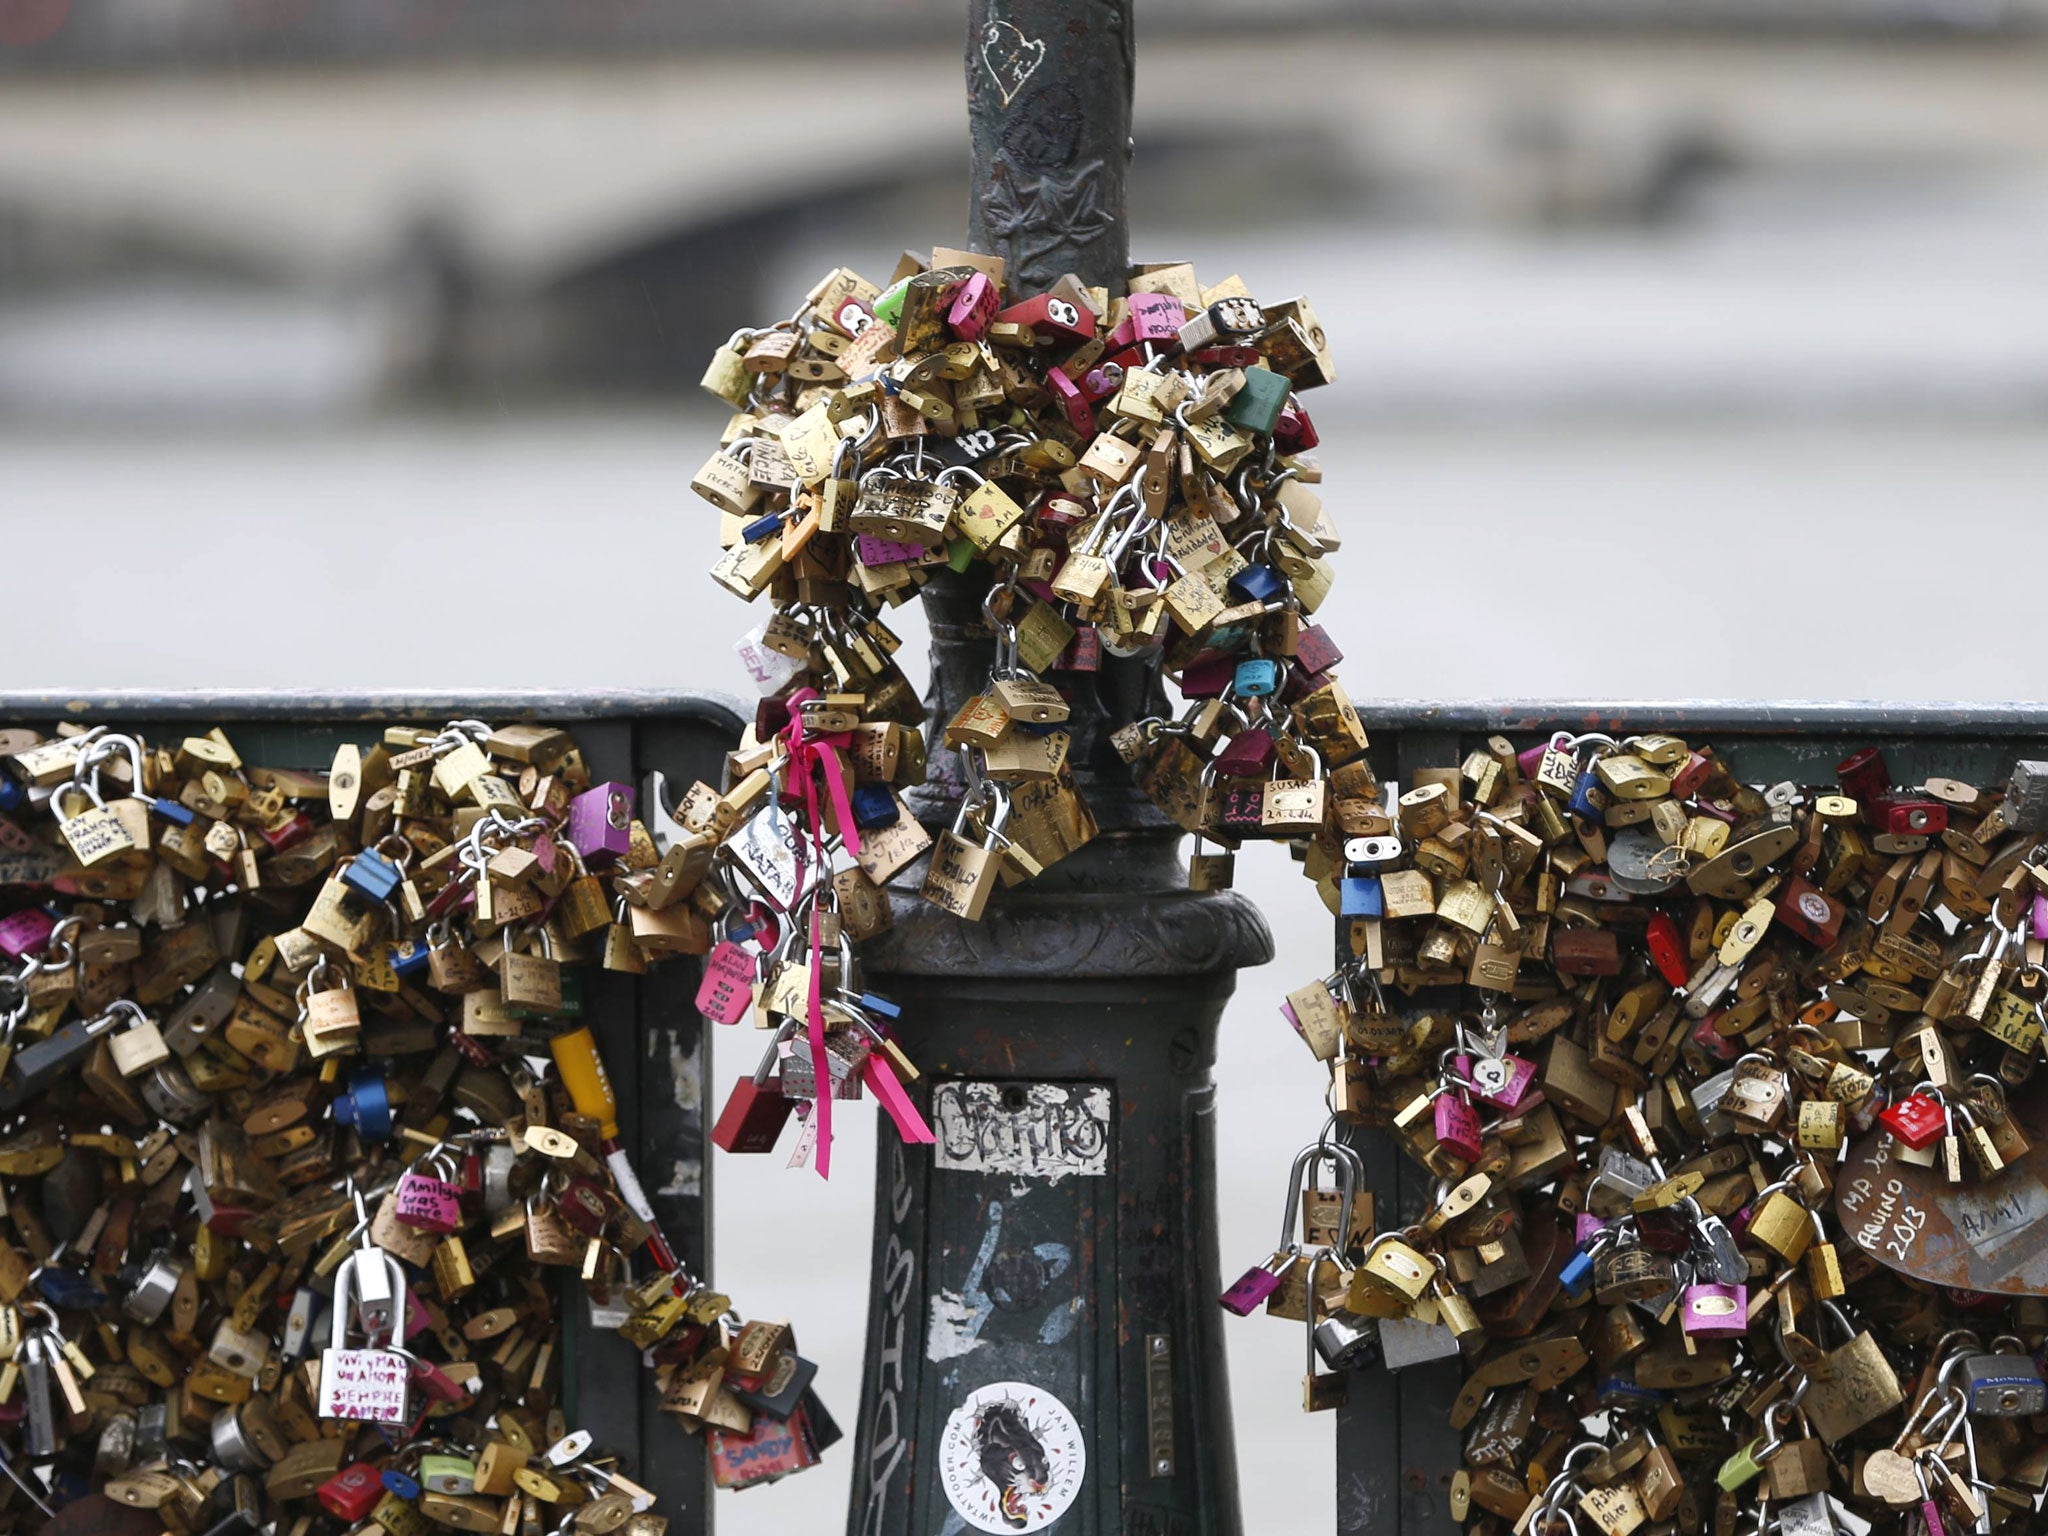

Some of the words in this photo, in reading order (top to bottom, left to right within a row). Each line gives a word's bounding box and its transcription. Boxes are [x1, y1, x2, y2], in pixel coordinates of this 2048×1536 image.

[1886, 1206, 1926, 1261] 2013
[1049, 1409, 1069, 1433] JAN
[1060, 1440, 1078, 1498] WILLEM
